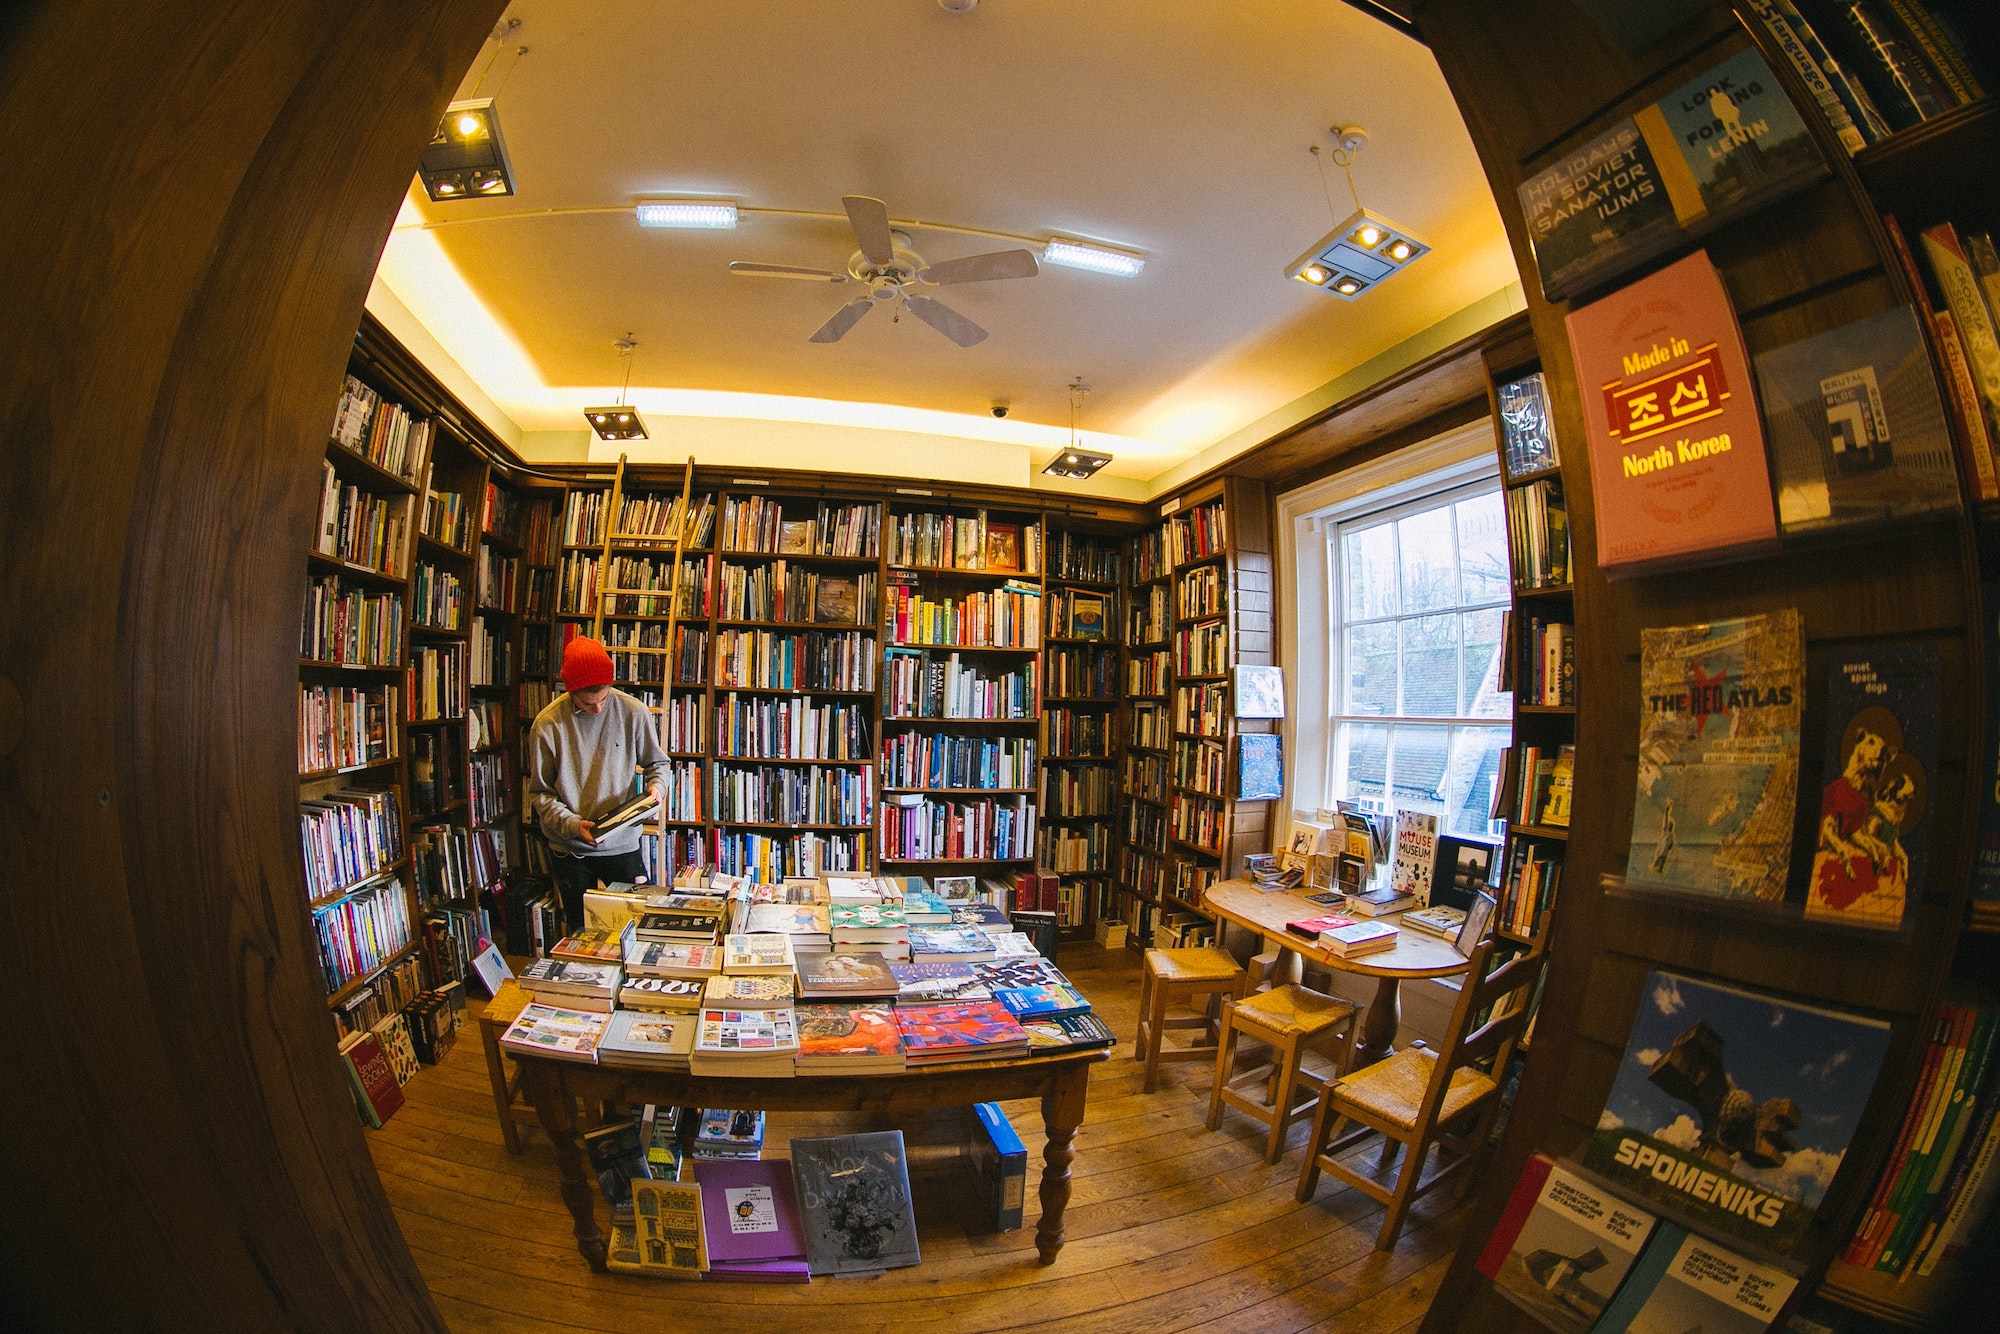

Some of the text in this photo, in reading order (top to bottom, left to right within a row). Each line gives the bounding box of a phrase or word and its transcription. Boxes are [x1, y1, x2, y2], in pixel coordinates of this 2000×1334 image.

[1681, 77, 1736, 112] LOOK
[1732, 81, 1765, 108] ING
[1686, 119, 1727, 147] FOR
[1707, 119, 1770, 159] LENIN
[1528, 130, 1636, 200] HOLIDAYS
[1533, 146, 1638, 218] IN SOVIET
[1537, 163, 1648, 233] SANATOR
[1598, 179, 1655, 221] IUMS
[1621, 336, 1690, 377] Made in
[1824, 373, 1864, 390] BRUTAL
[1628, 374, 1710, 432] 조선
[1622, 433, 1732, 478] North Korea
[1851, 672, 1878, 685] space
[1865, 682, 1888, 696] dogs
[1649, 686, 1793, 715] THE RED ATLAS
[1400, 830, 1432, 848] MOUSE
[1399, 842, 1431, 860] MUSEUM
[889, 963, 951, 971] EDWARD
[906, 967, 968, 975] BAWDEN
[360, 1053, 384, 1078] SEWING
[363, 1068, 382, 1088] BOOK
[1614, 1137, 1785, 1228] SPOMENIKS
[1948, 1170, 1982, 1224] dictionary
[1610, 1217, 1626, 1229] BUS
[1613, 1210, 1642, 1229] SOVIET
[1606, 1223, 1632, 1240] STOPS
[1743, 1280, 1760, 1291] BUS
[1748, 1273, 1776, 1290] SOVIET
[1736, 1293, 1766, 1313] VOLUME
[1739, 1286, 1765, 1302] STOPS
